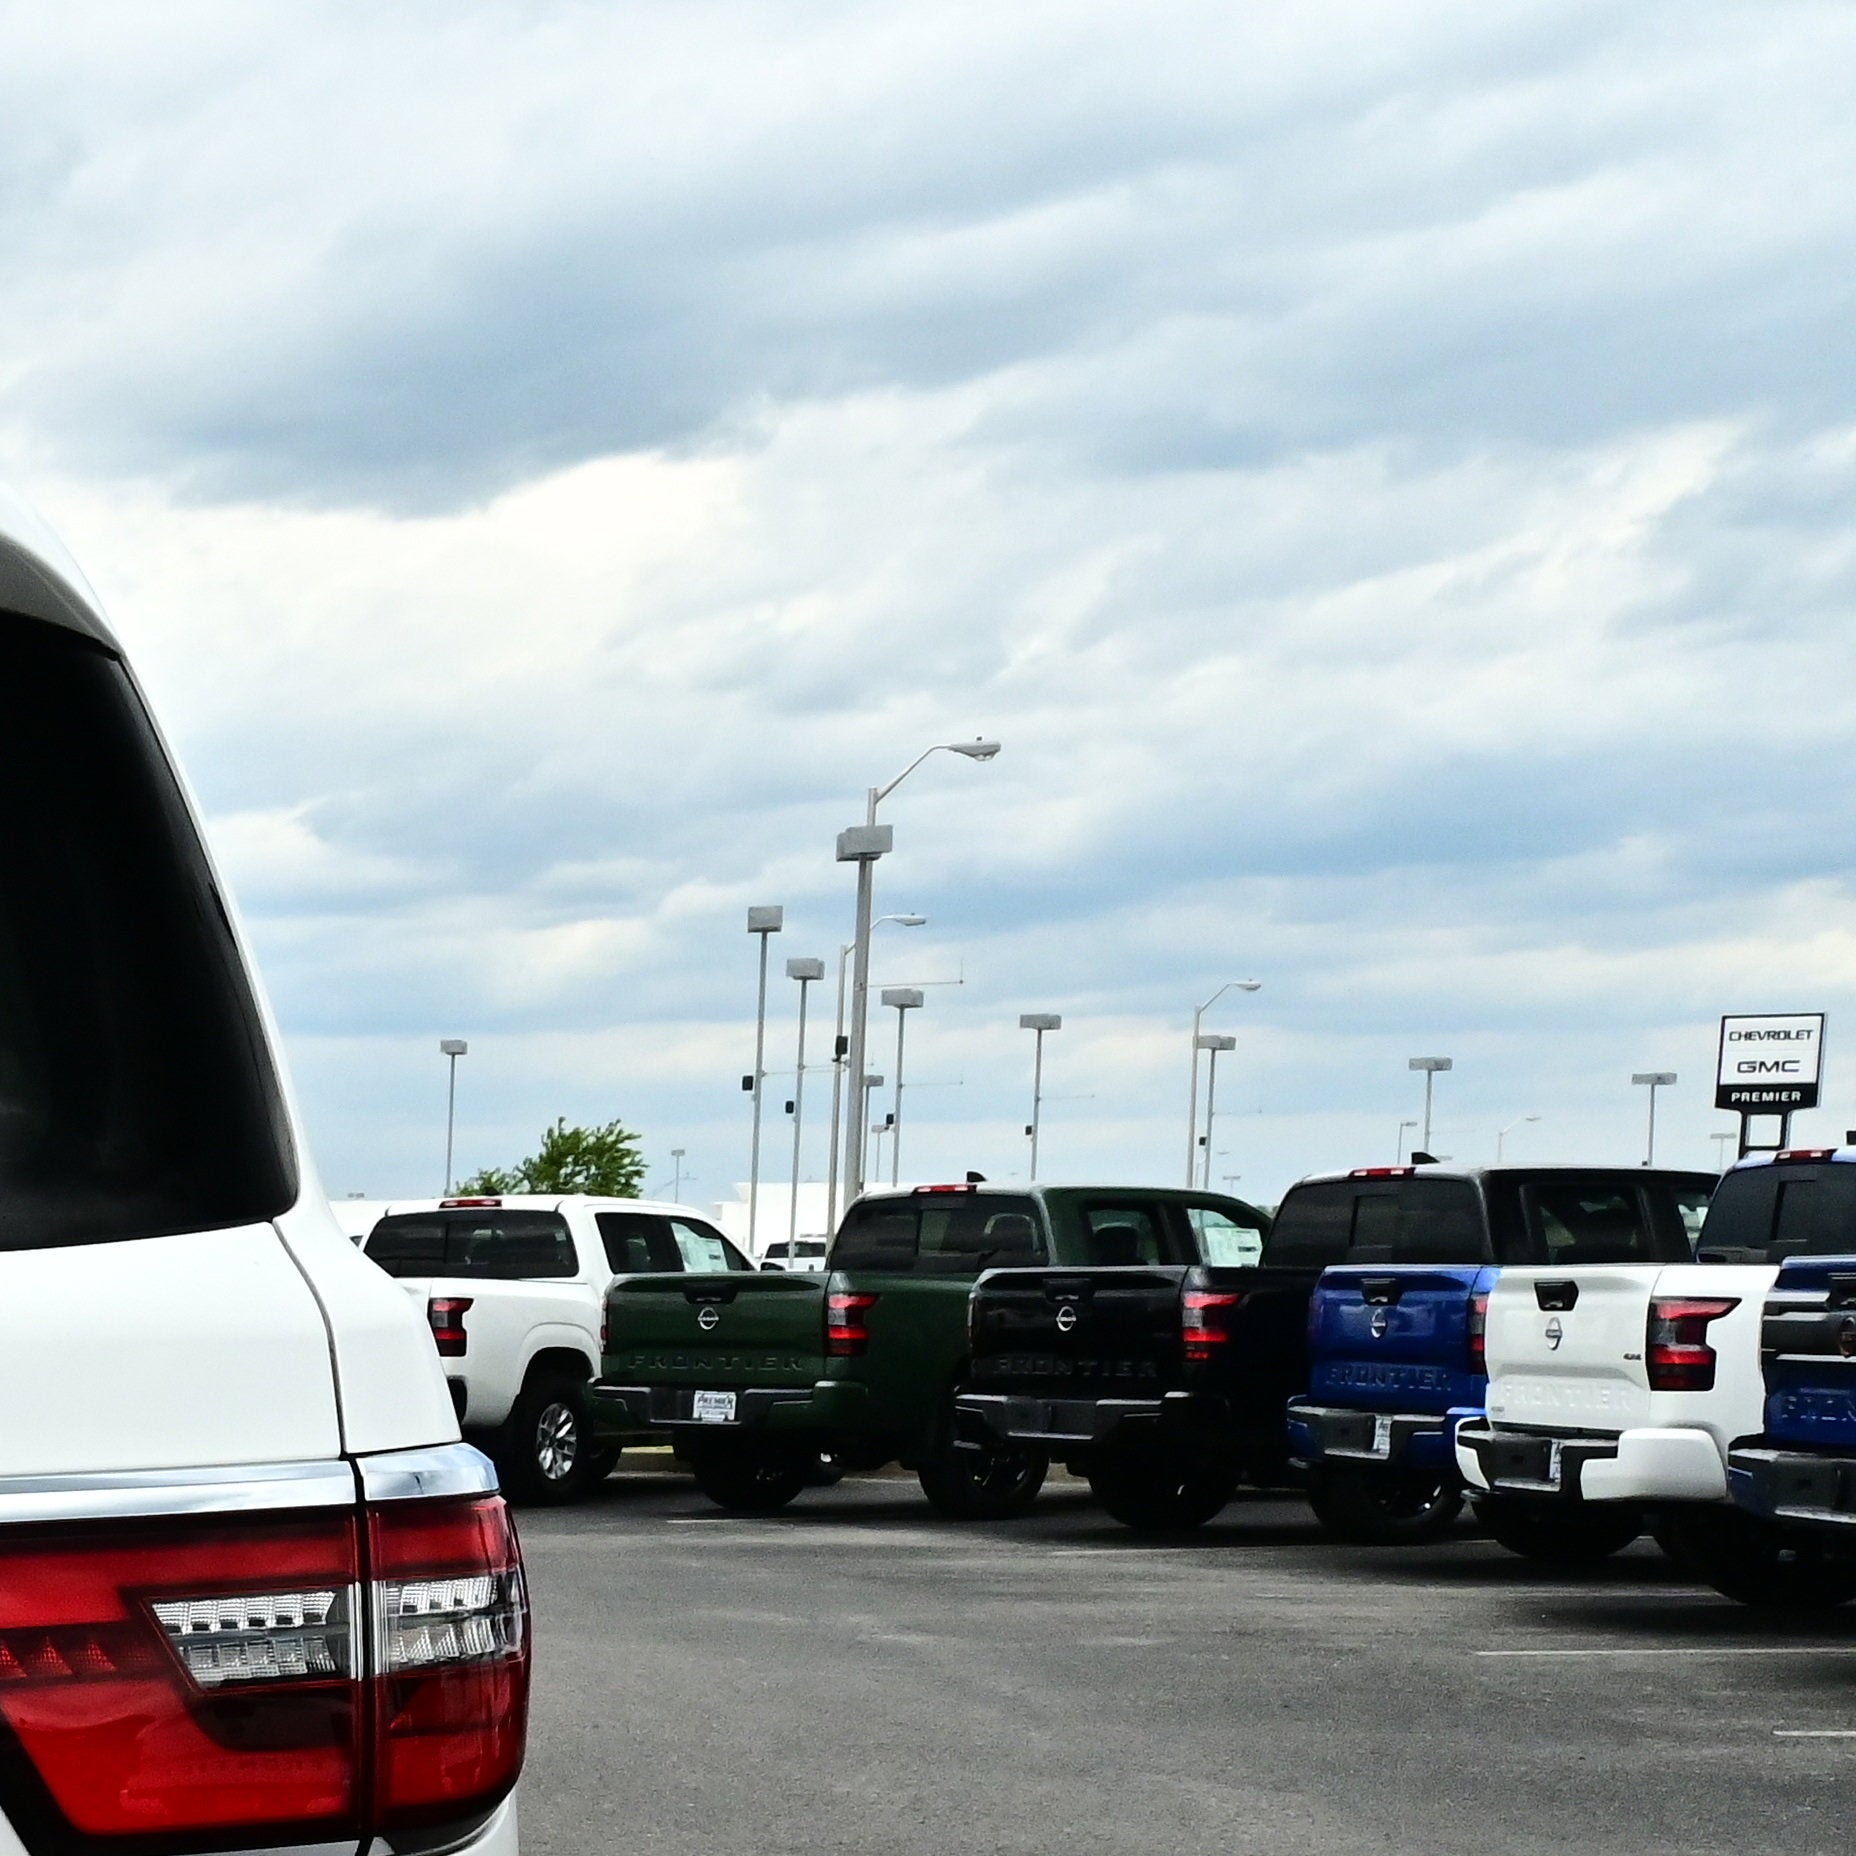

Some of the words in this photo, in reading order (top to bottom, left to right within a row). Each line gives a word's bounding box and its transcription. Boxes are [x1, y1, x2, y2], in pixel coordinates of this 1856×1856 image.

[1729, 1029, 1813, 1042] CHEVROLET
[1737, 1060, 1800, 1073] GMC
[1731, 1091, 1801, 1102] PREMIER
